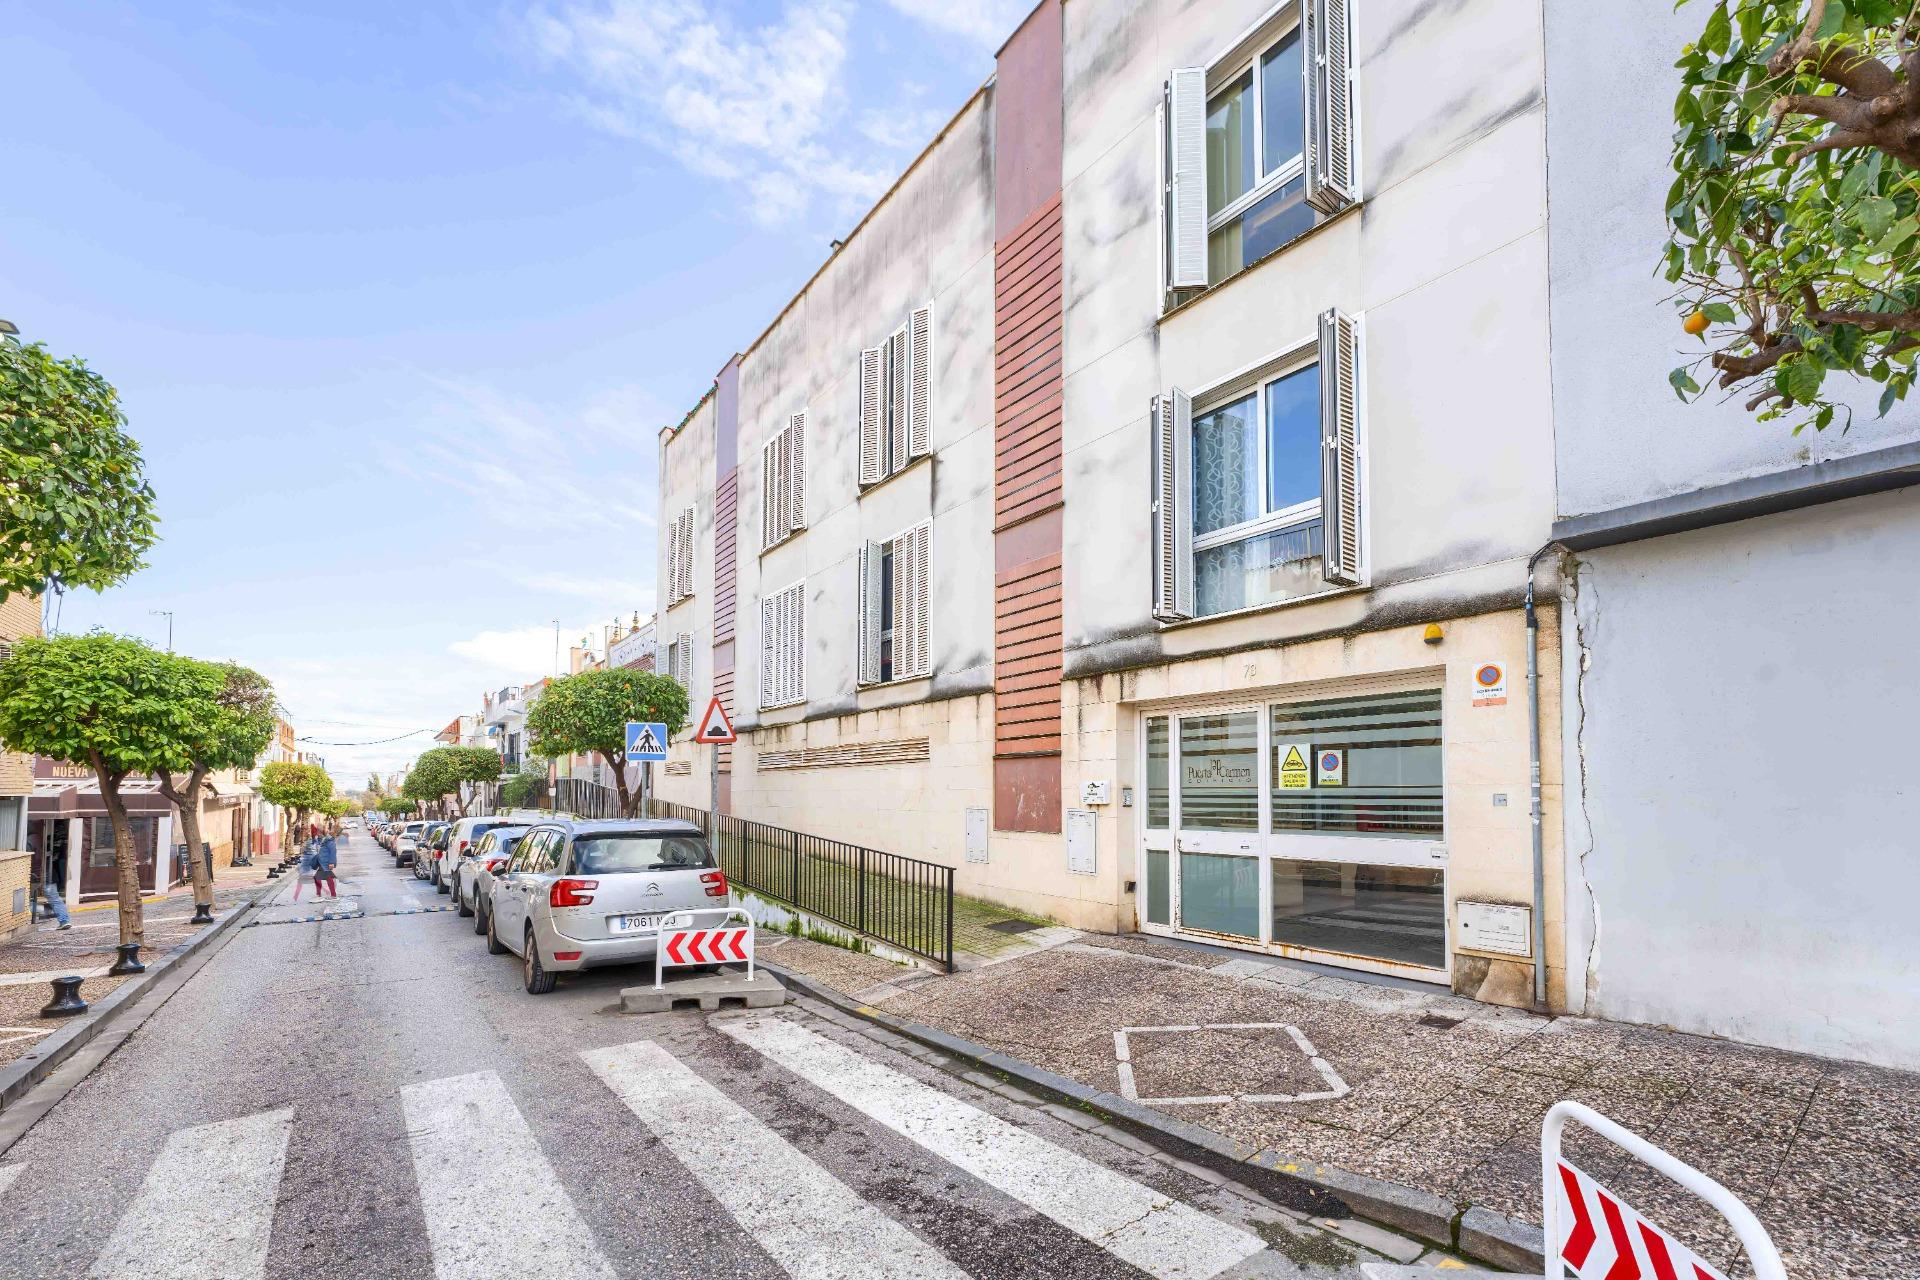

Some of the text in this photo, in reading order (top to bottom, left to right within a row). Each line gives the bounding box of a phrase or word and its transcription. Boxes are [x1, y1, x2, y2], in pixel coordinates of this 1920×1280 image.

[53, 766, 89, 778] NUEVA
[1188, 767, 1212, 778] Puerta
[1220, 766, 1251, 778] Carmen
[627, 917, 653, 928] 7061
